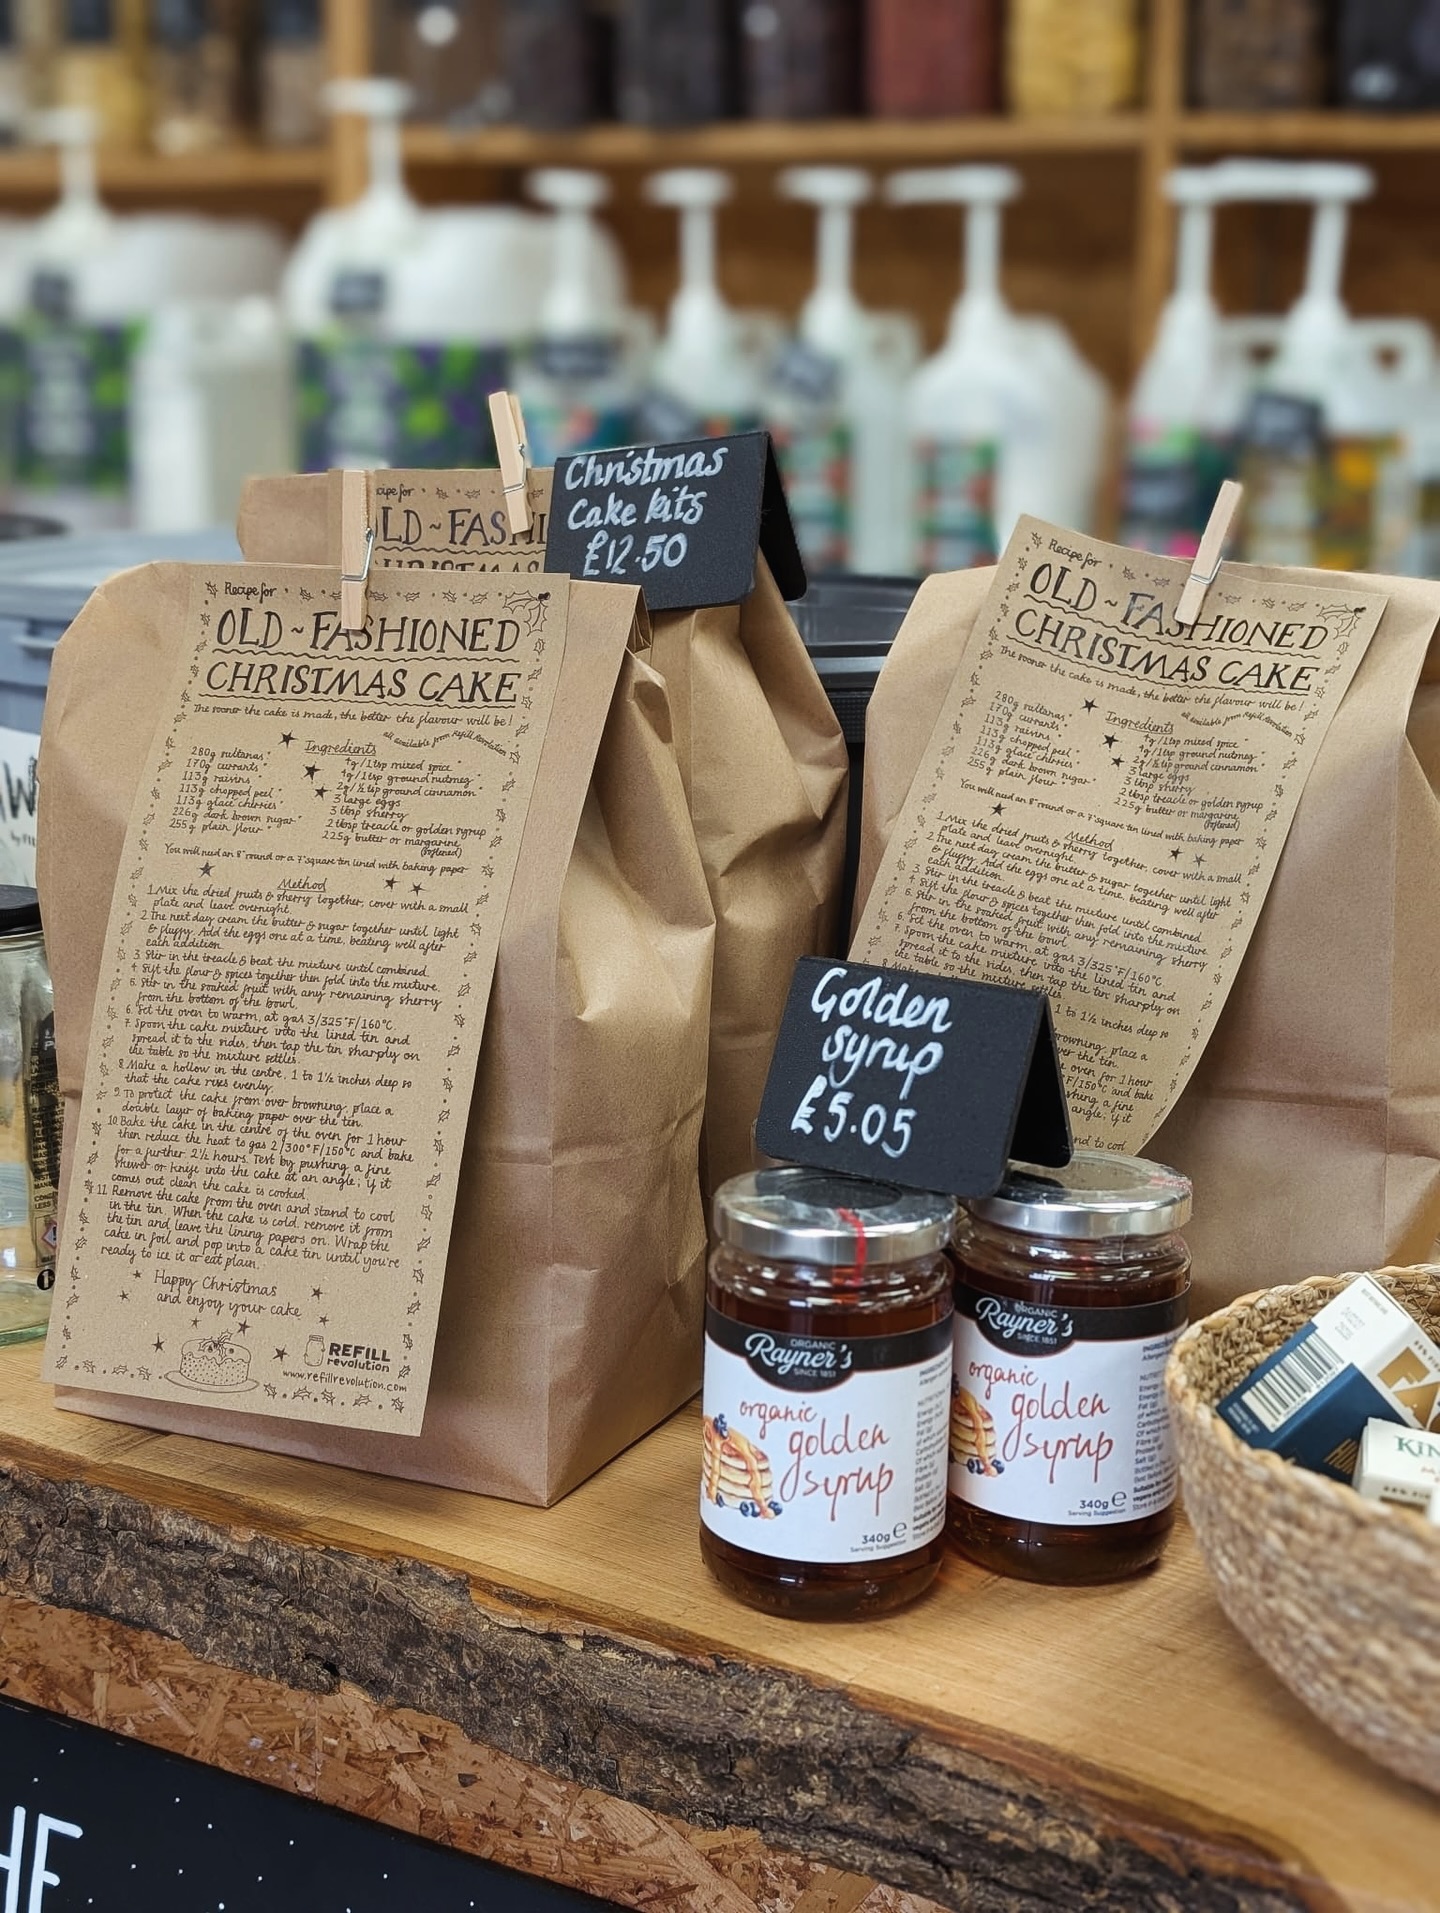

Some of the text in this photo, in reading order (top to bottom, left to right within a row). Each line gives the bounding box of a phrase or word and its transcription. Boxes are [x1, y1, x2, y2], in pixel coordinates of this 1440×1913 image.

[565, 446, 729, 490] Christmas
[375, 484, 398, 500] cipe
[567, 485, 708, 532] Cake kits
[374, 506, 422, 546] LD
[583, 532, 689, 578] £12.50
[1047, 537, 1103, 570] Recipe for
[224, 580, 277, 604] Recipe for
[1029, 562, 1097, 612] OLD
[216, 606, 521, 654] OLD FASHIONED
[999, 644, 1016, 659] The
[1014, 608, 1321, 692] CHRISTMAS CAKE
[205, 660, 523, 703] CHRISTMAS CAKE
[193, 703, 210, 713] The
[243, 703, 261, 716] the
[263, 706, 288, 717] cake
[290, 710, 300, 718] is
[339, 708, 357, 721] the
[359, 710, 392, 722] better
[395, 710, 415, 724] the
[415, 710, 463, 732] flavour
[465, 713, 491, 726] will
[1104, 709, 1174, 735] Ingredients
[189, 745, 264, 761] 280g sultanas
[303, 737, 377, 757] Ingredients
[185, 757, 259, 772] 170g currants
[389, 759, 426, 771] mixed
[181, 770, 251, 785] 113g raisins
[386, 772, 430, 786] ground
[178, 782, 275, 801] 113g chopped peel
[381, 784, 477, 797] ground cinnamon
[175, 794, 203, 809] 113g
[237, 797, 277, 810] cherries
[332, 793, 401, 811] 3 large eggs
[171, 806, 200, 821] 226g
[202, 808, 229, 820] dark
[230, 810, 261, 822] brown
[329, 805, 337, 816] 3
[365, 806, 410, 824] sherry
[168, 817, 264, 837] 255g plain flour
[321, 829, 354, 847] 225g
[354, 832, 388, 843] butter
[388, 836, 402, 845] or
[324, 818, 334, 828] 2
[400, 824, 414, 833] or
[415, 822, 453, 837] golden
[455, 826, 487, 840] syrup
[1063, 830, 1115, 852] Method
[276, 875, 328, 893] Method
[811, 967, 953, 1034] Golden
[821, 1024, 945, 1101] syrup
[790, 1074, 918, 1158] £5.05
[111, 1183, 395, 1224] Remove the cake from the oven and stand to cool
[153, 1268, 278, 1297] Happy Christmas
[155, 1288, 303, 1321] and enjoy your cake
[1015, 1301, 1058, 1319] ORGANIC
[975, 1297, 1073, 1339] Rayner's
[328, 1341, 391, 1363] REFILL
[745, 1332, 853, 1375] Rayner's
[790, 1338, 836, 1350] ORGANIC
[326, 1357, 390, 1373] revolution
[793, 1368, 818, 1377] SINCE
[282, 1370, 407, 1392] www.refillrevolution.com
[968, 1361, 1039, 1400] organic
[739, 1401, 819, 1441] organic
[1002, 1380, 1111, 1463] golden
[779, 1413, 891, 1503] golden
[1023, 1431, 1114, 1484] syrup
[802, 1462, 895, 1522] syrup
[1079, 1499, 1109, 1510] 340g
[861, 1533, 891, 1546] 340g
